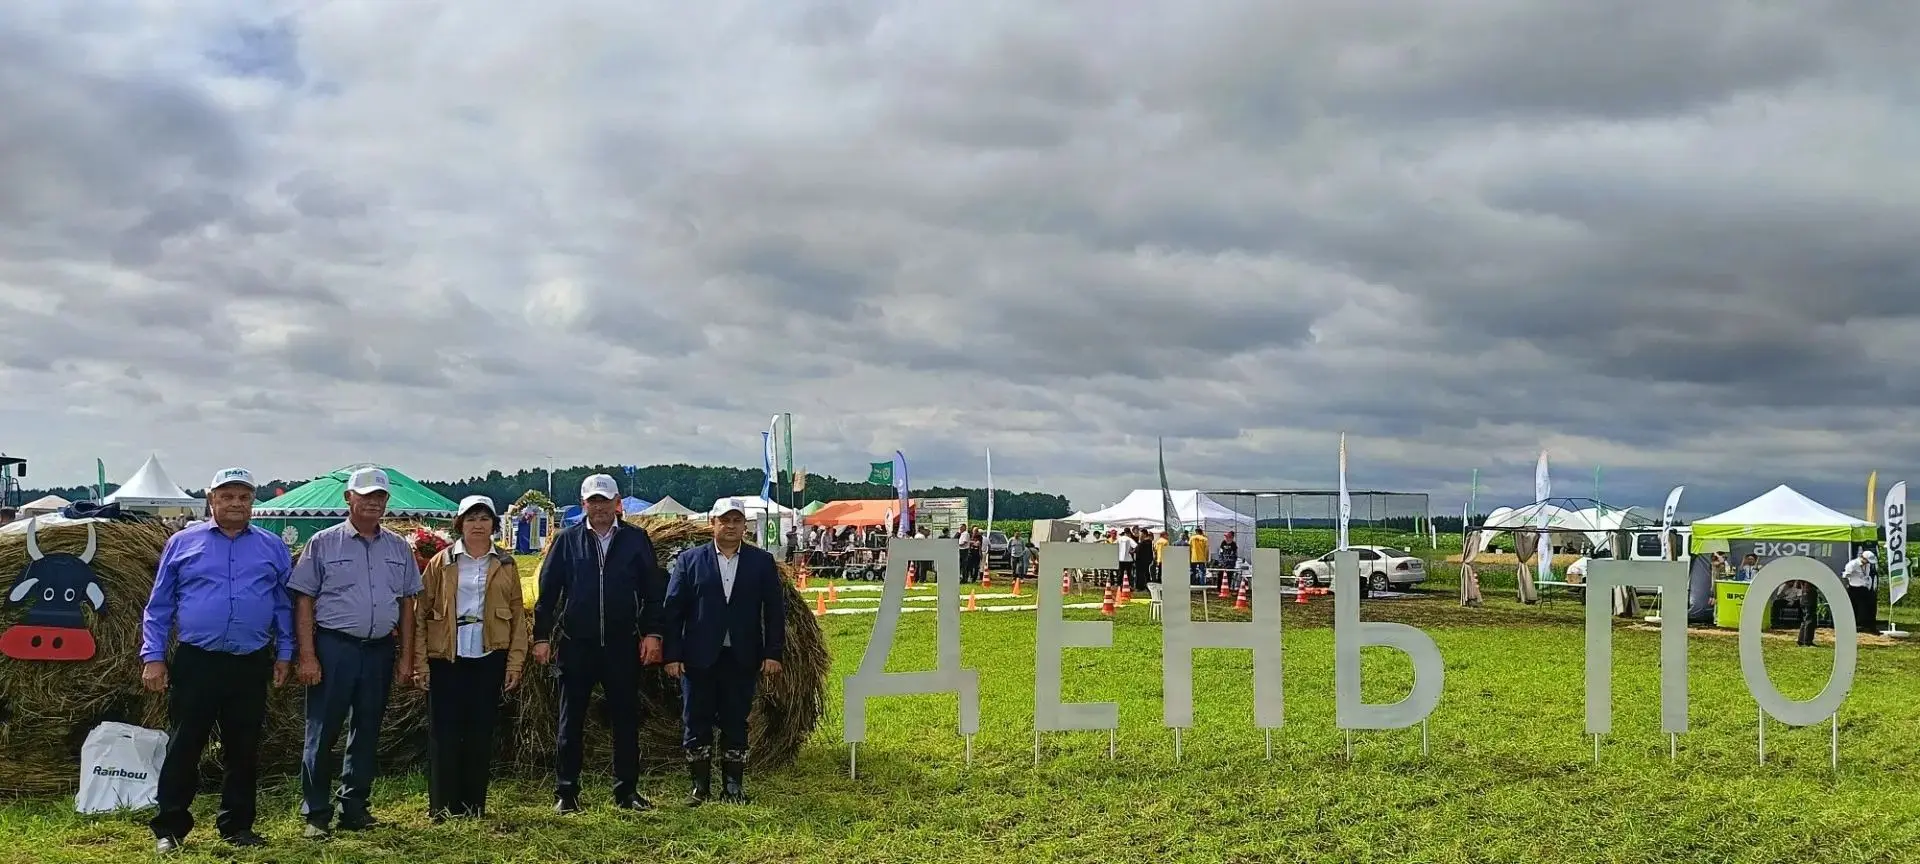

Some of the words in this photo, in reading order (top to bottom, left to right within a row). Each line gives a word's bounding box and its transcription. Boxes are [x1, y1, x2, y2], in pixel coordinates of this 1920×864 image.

[844, 538, 1445, 743] ДЕНЬ
[1585, 556, 1857, 734] ПО
[93, 766, 148, 780] Rainbow
